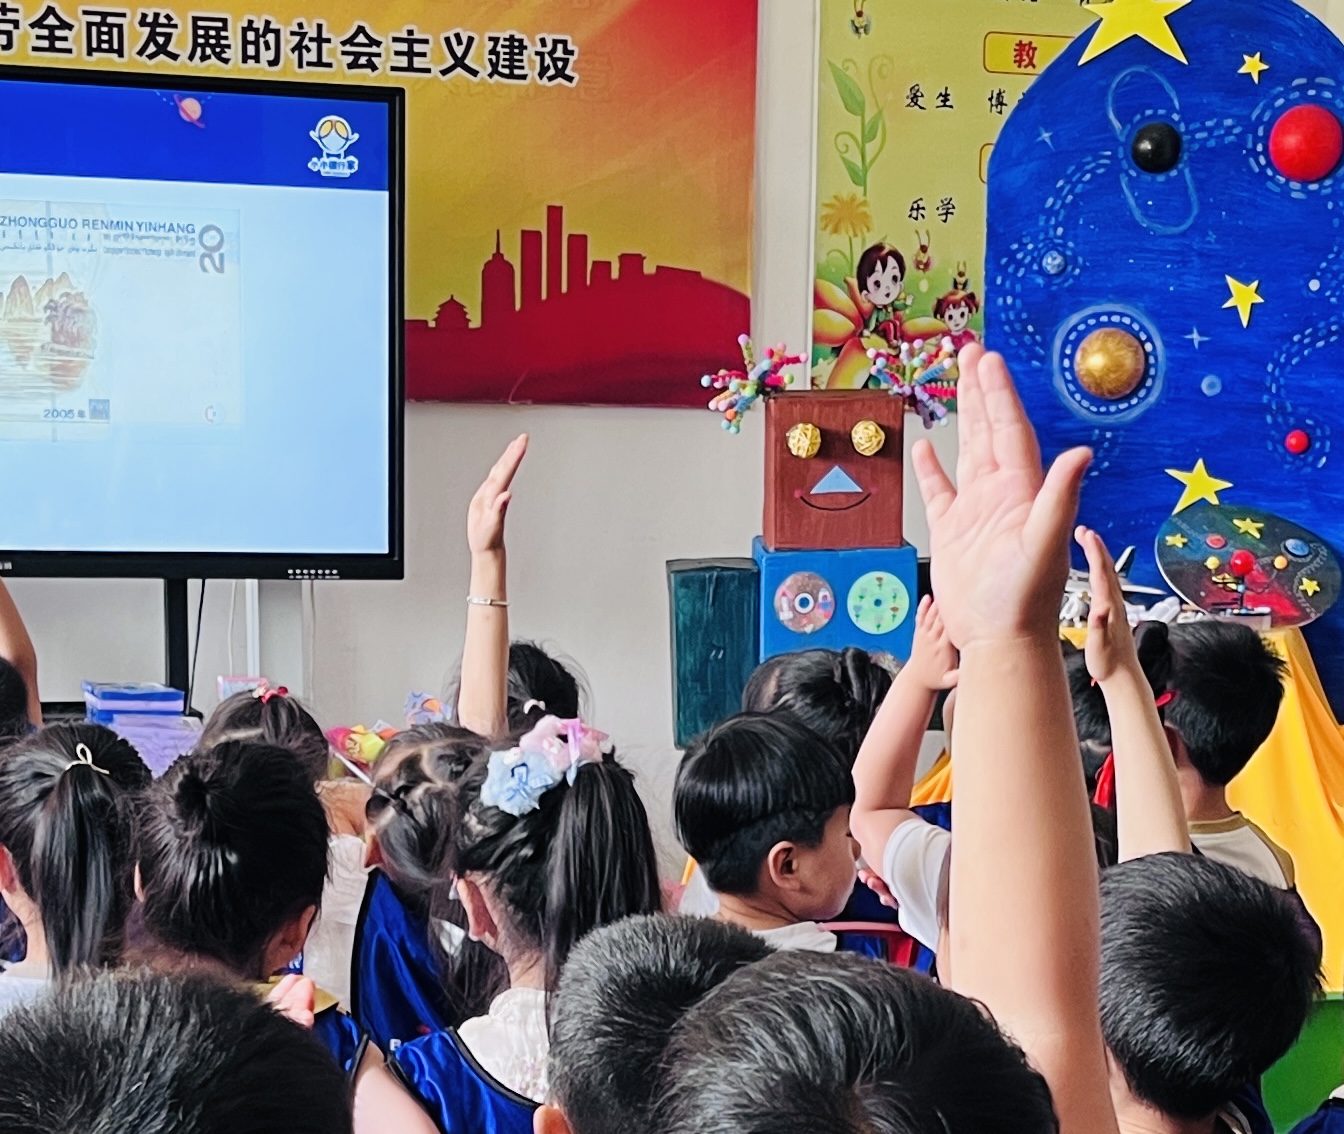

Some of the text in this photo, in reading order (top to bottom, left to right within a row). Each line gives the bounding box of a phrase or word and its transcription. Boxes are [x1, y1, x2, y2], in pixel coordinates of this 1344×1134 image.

[1013, 40, 1038, 69] 教
[0, 215, 196, 234] ZHONGGUO RENMIN YINHANG
[908, 198, 956, 224] 乐学
[198, 224, 225, 274] 20
